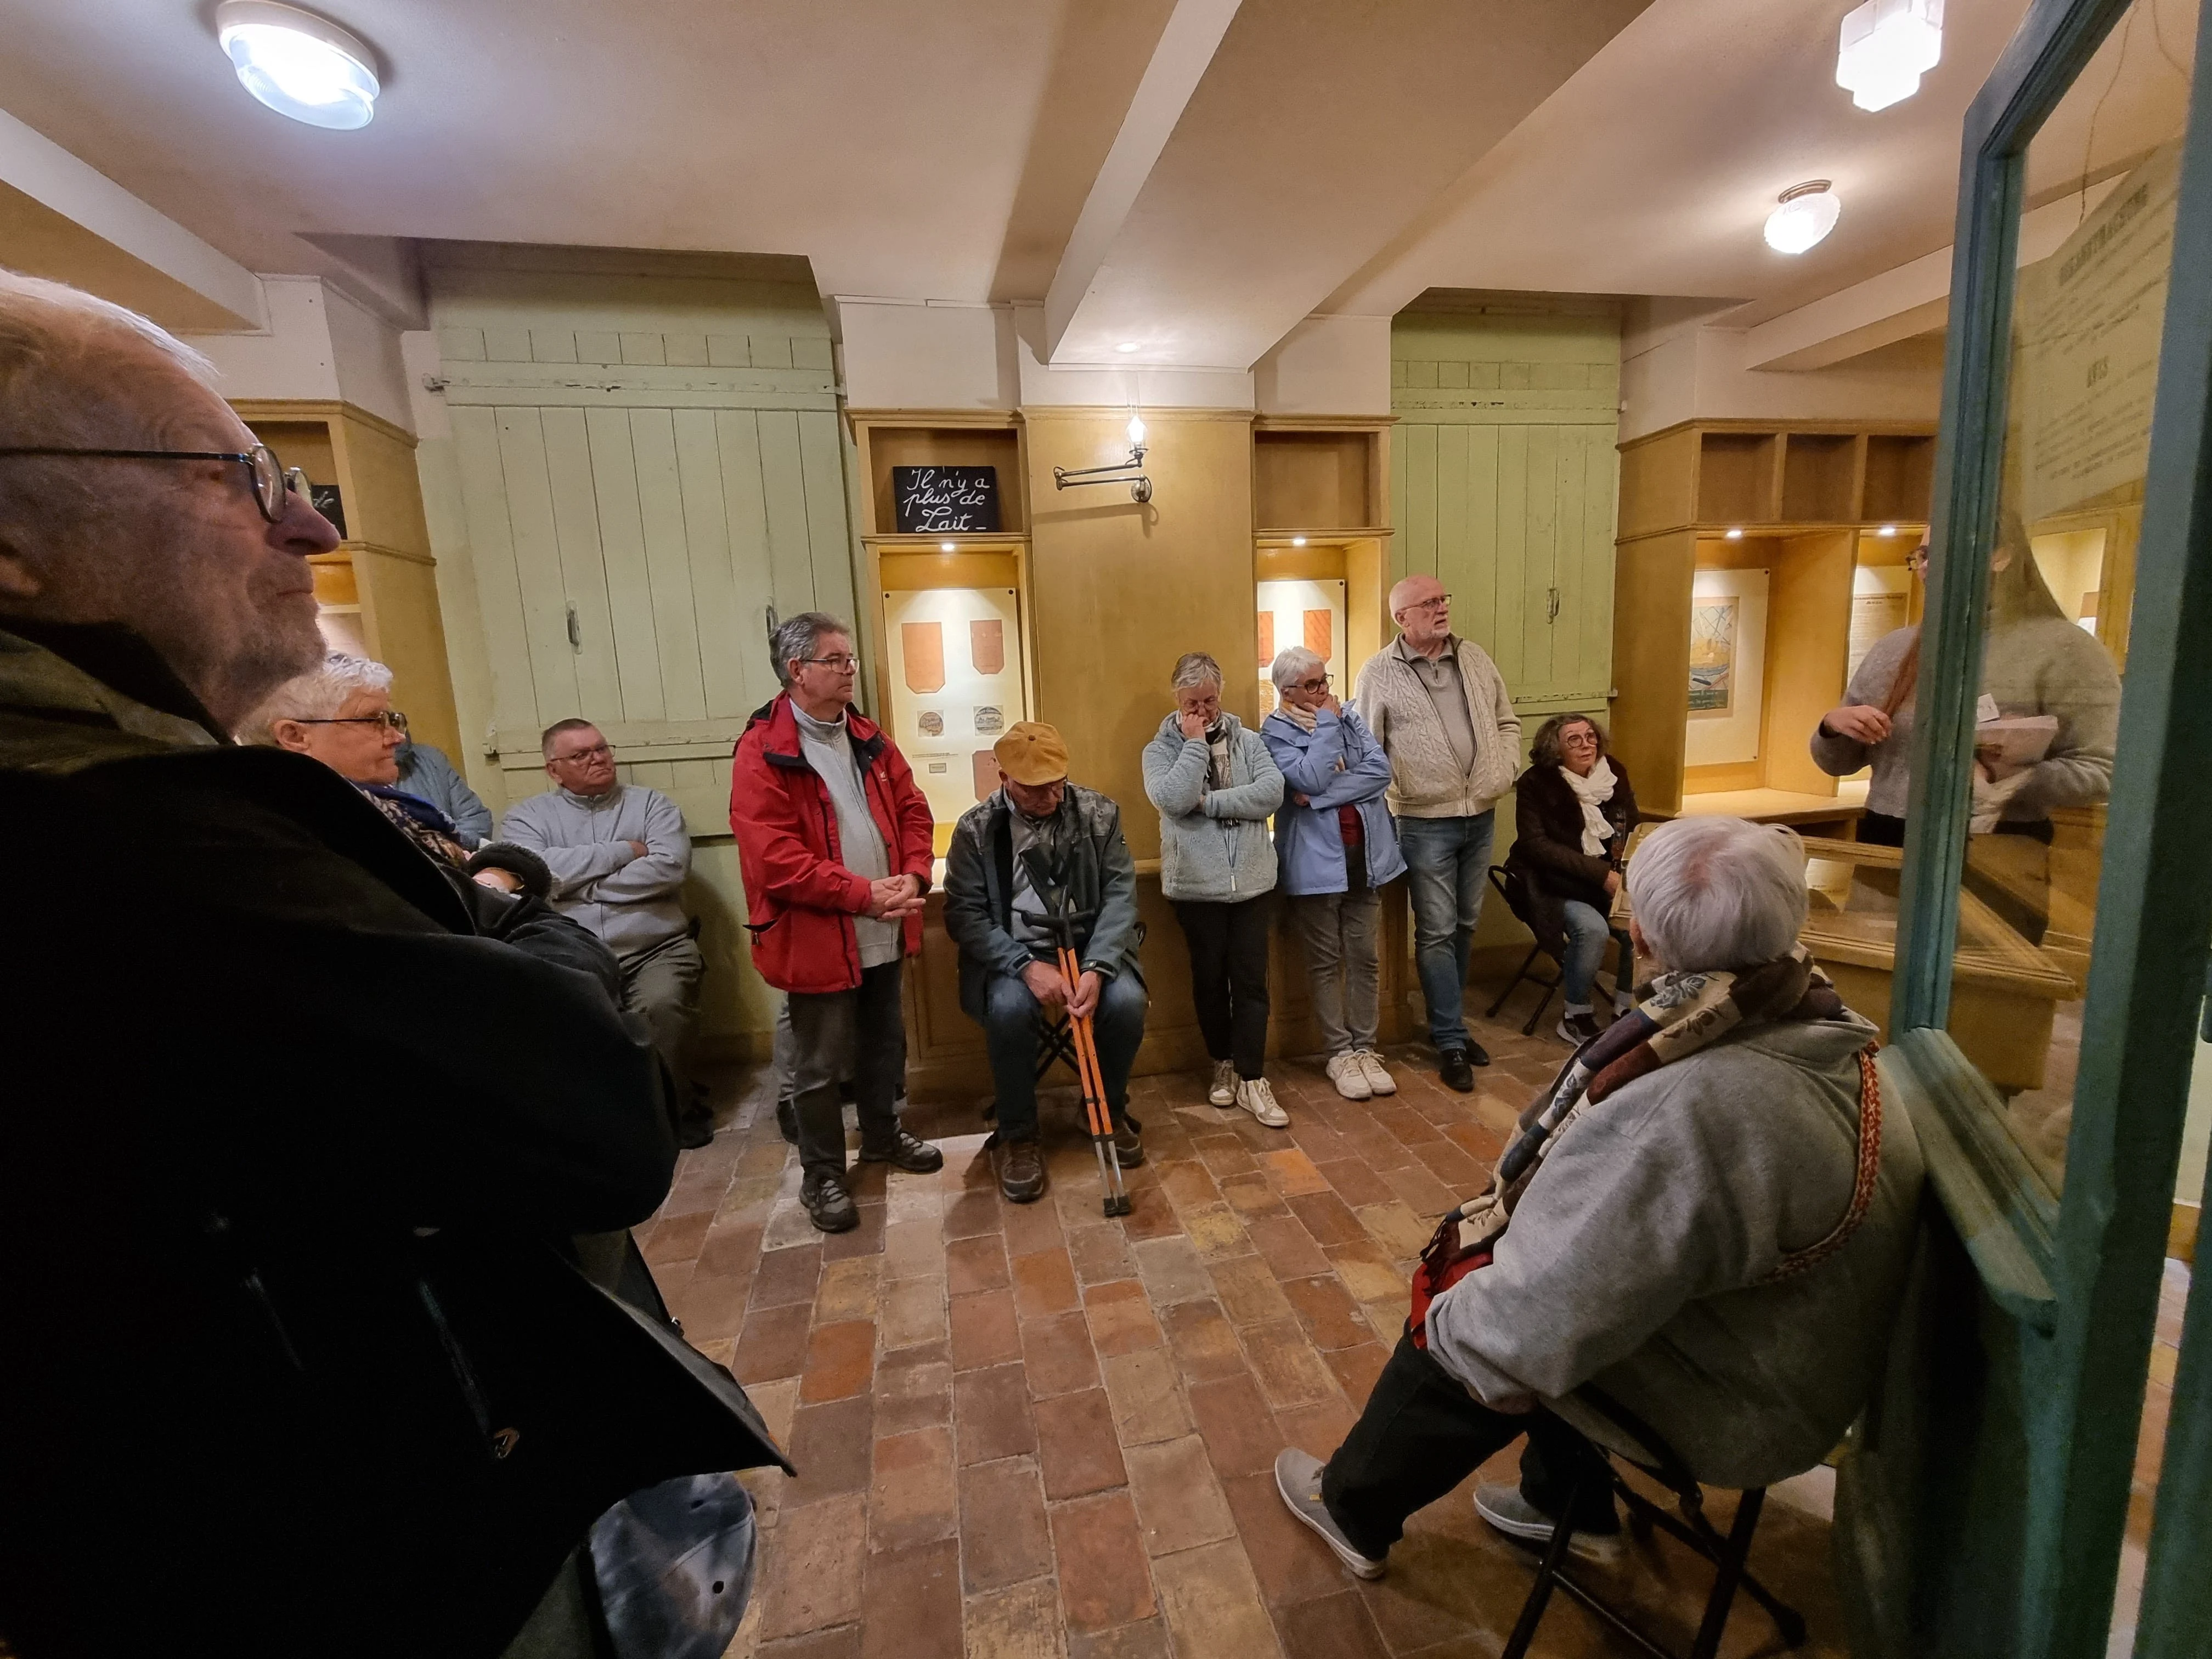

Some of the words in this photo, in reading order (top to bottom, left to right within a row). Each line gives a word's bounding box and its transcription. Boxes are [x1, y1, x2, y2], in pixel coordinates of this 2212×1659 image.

[907, 468, 935, 490] Il
[939, 471, 968, 498] n'y
[975, 478, 991, 489] a
[903, 488, 951, 517] plus
[959, 490, 986, 505] de
[915, 506, 973, 533] Lait
